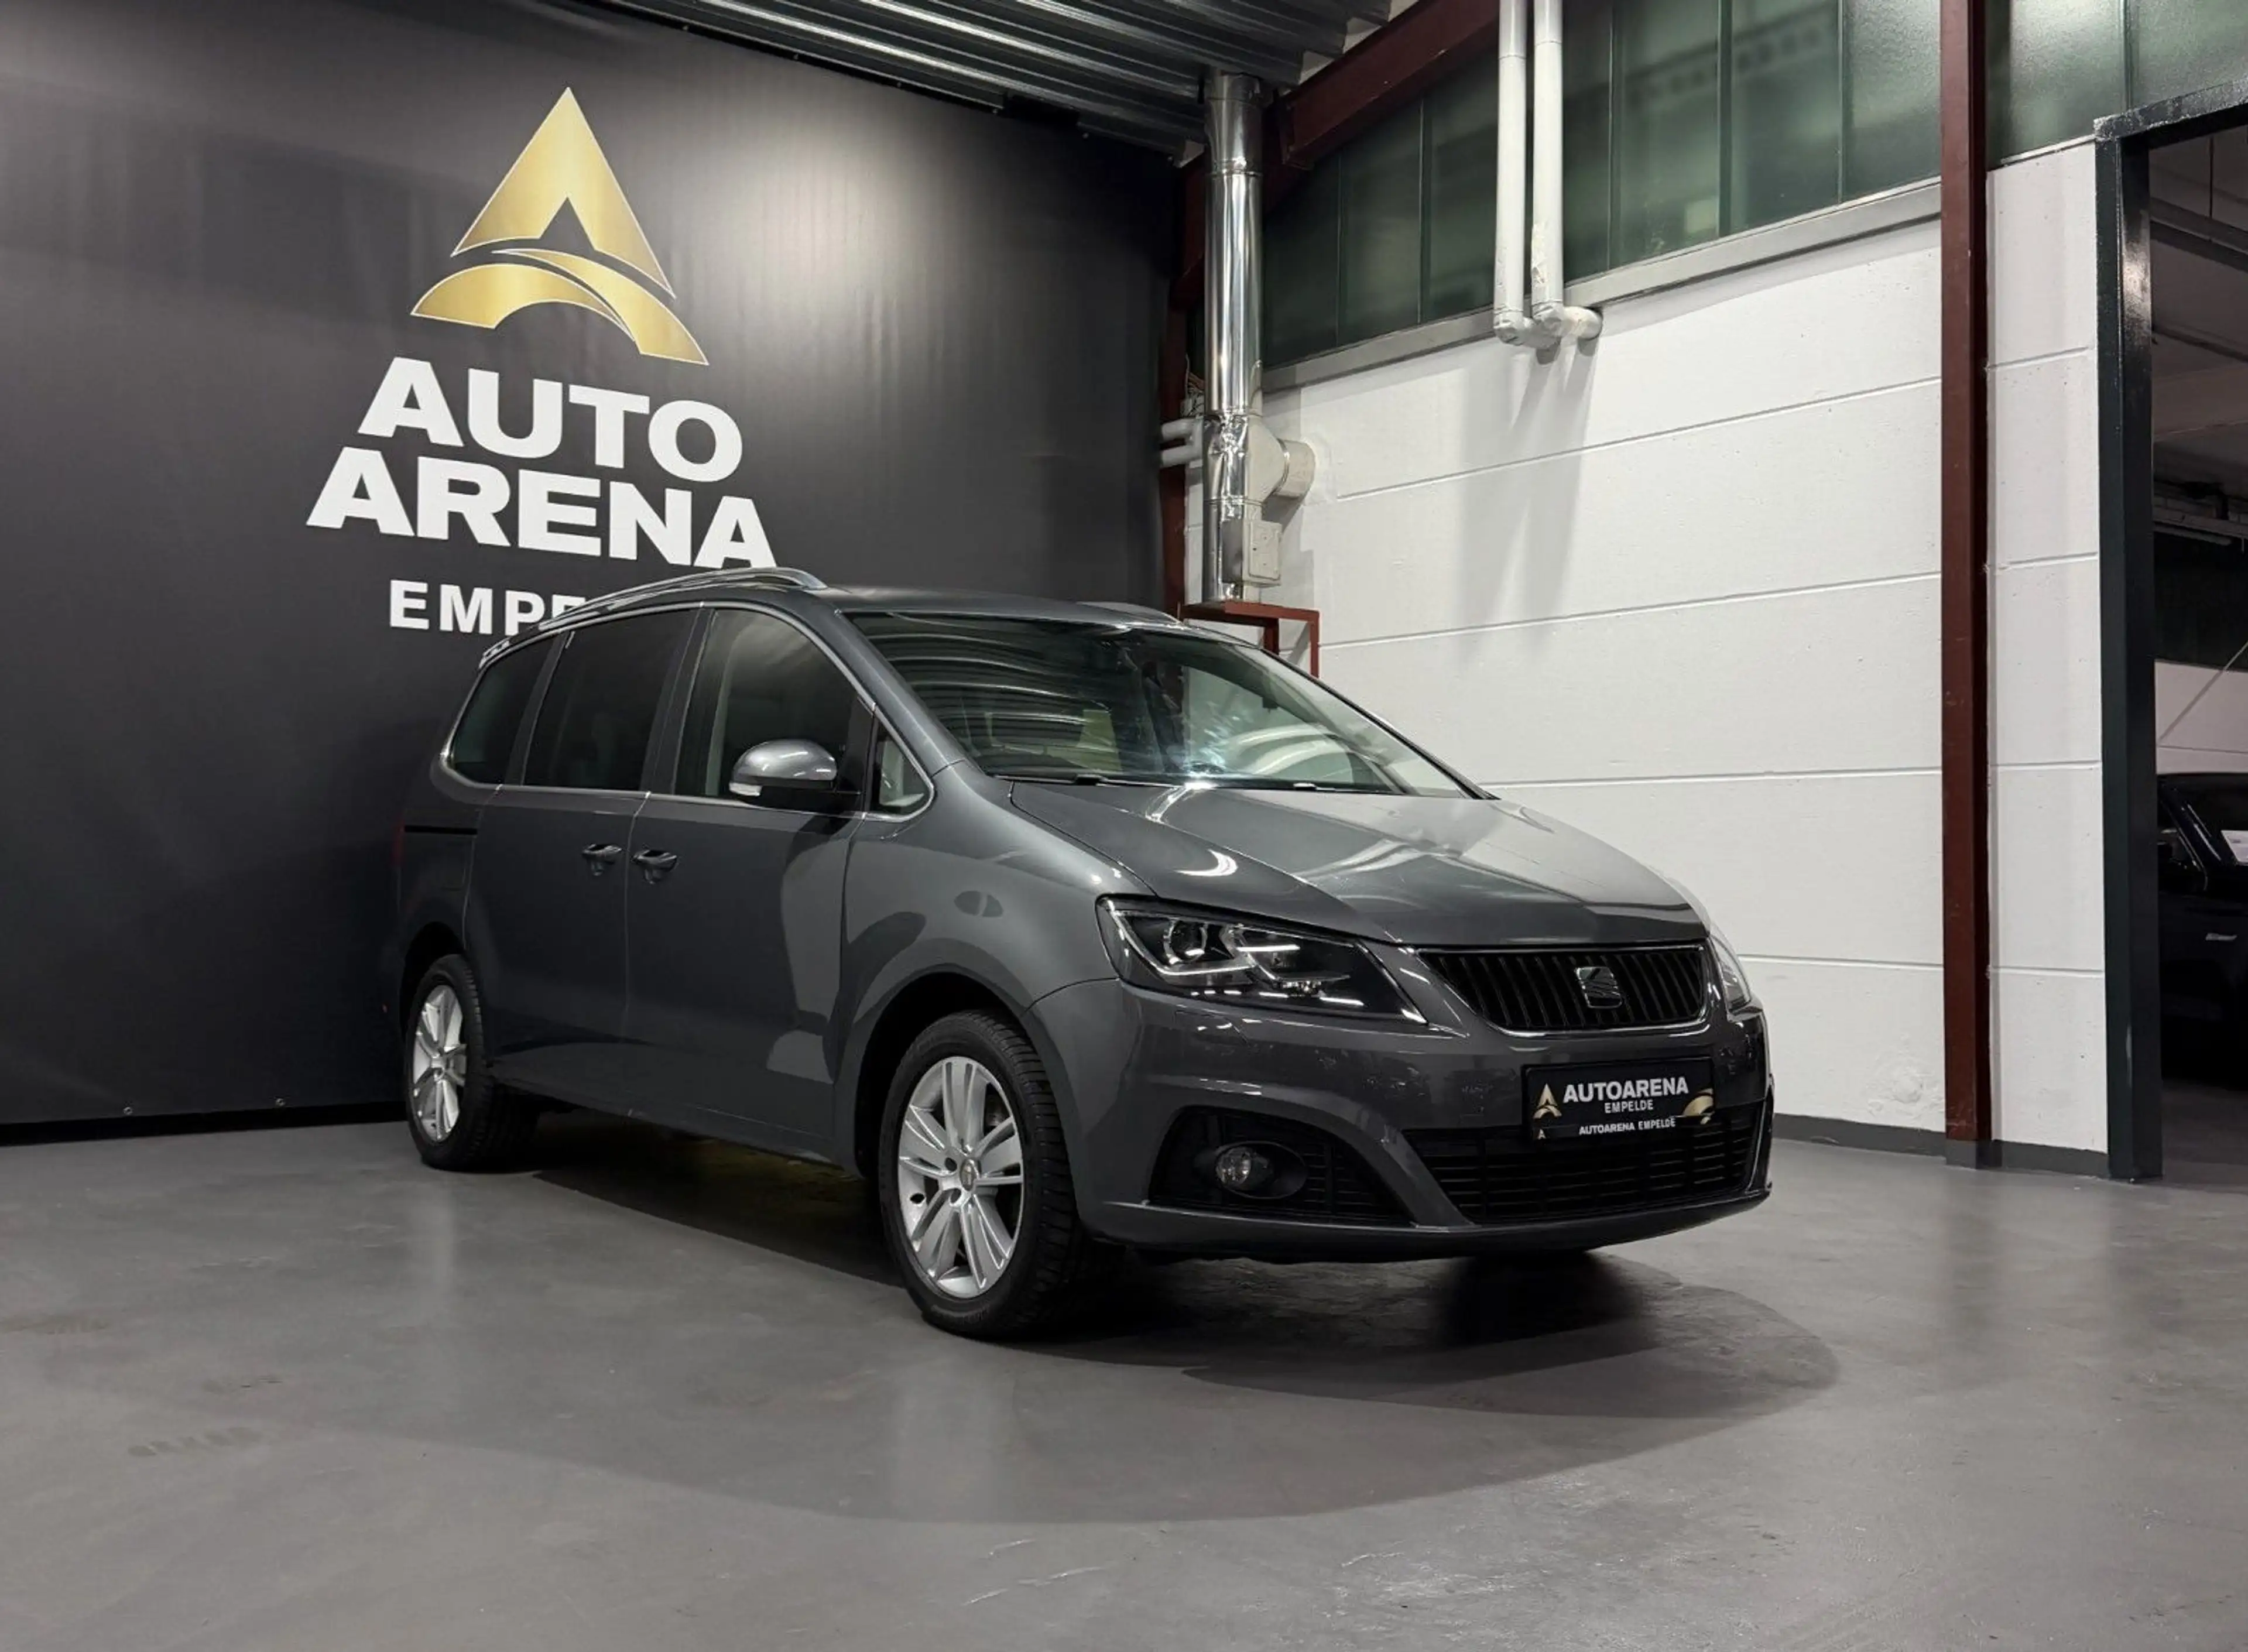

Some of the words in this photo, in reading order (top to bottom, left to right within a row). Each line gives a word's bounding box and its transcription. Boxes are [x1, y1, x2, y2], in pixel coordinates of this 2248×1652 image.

[358, 356, 743, 482] AUTO
[306, 446, 777, 568] ARENA
[1563, 1076, 1689, 1103] AUTOARENA
[1604, 1099, 1654, 1114] EMPELDE
[1579, 1122, 1636, 1136] AUTOARENA
[1637, 1118, 1677, 1130] EMPELDE
